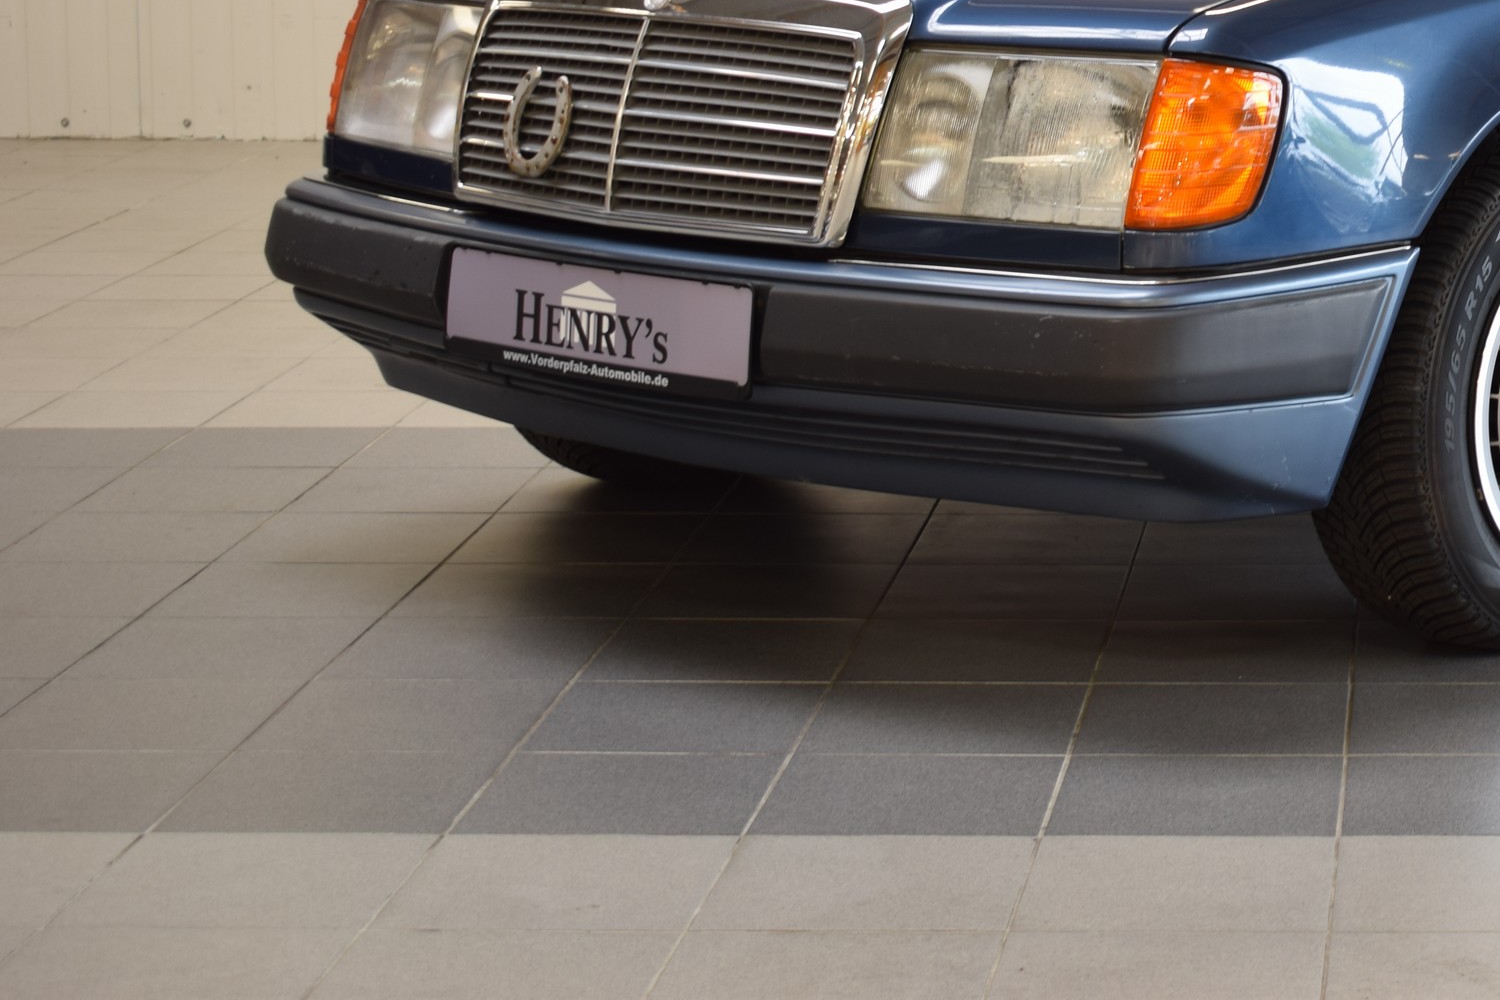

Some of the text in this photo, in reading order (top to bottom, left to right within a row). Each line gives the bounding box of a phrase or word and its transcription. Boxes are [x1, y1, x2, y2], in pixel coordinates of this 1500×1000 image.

[503, 350, 669, 388] www.Vorderpfalz-Automobile.de
[1443, 255, 1493, 453] 195/65 R15
